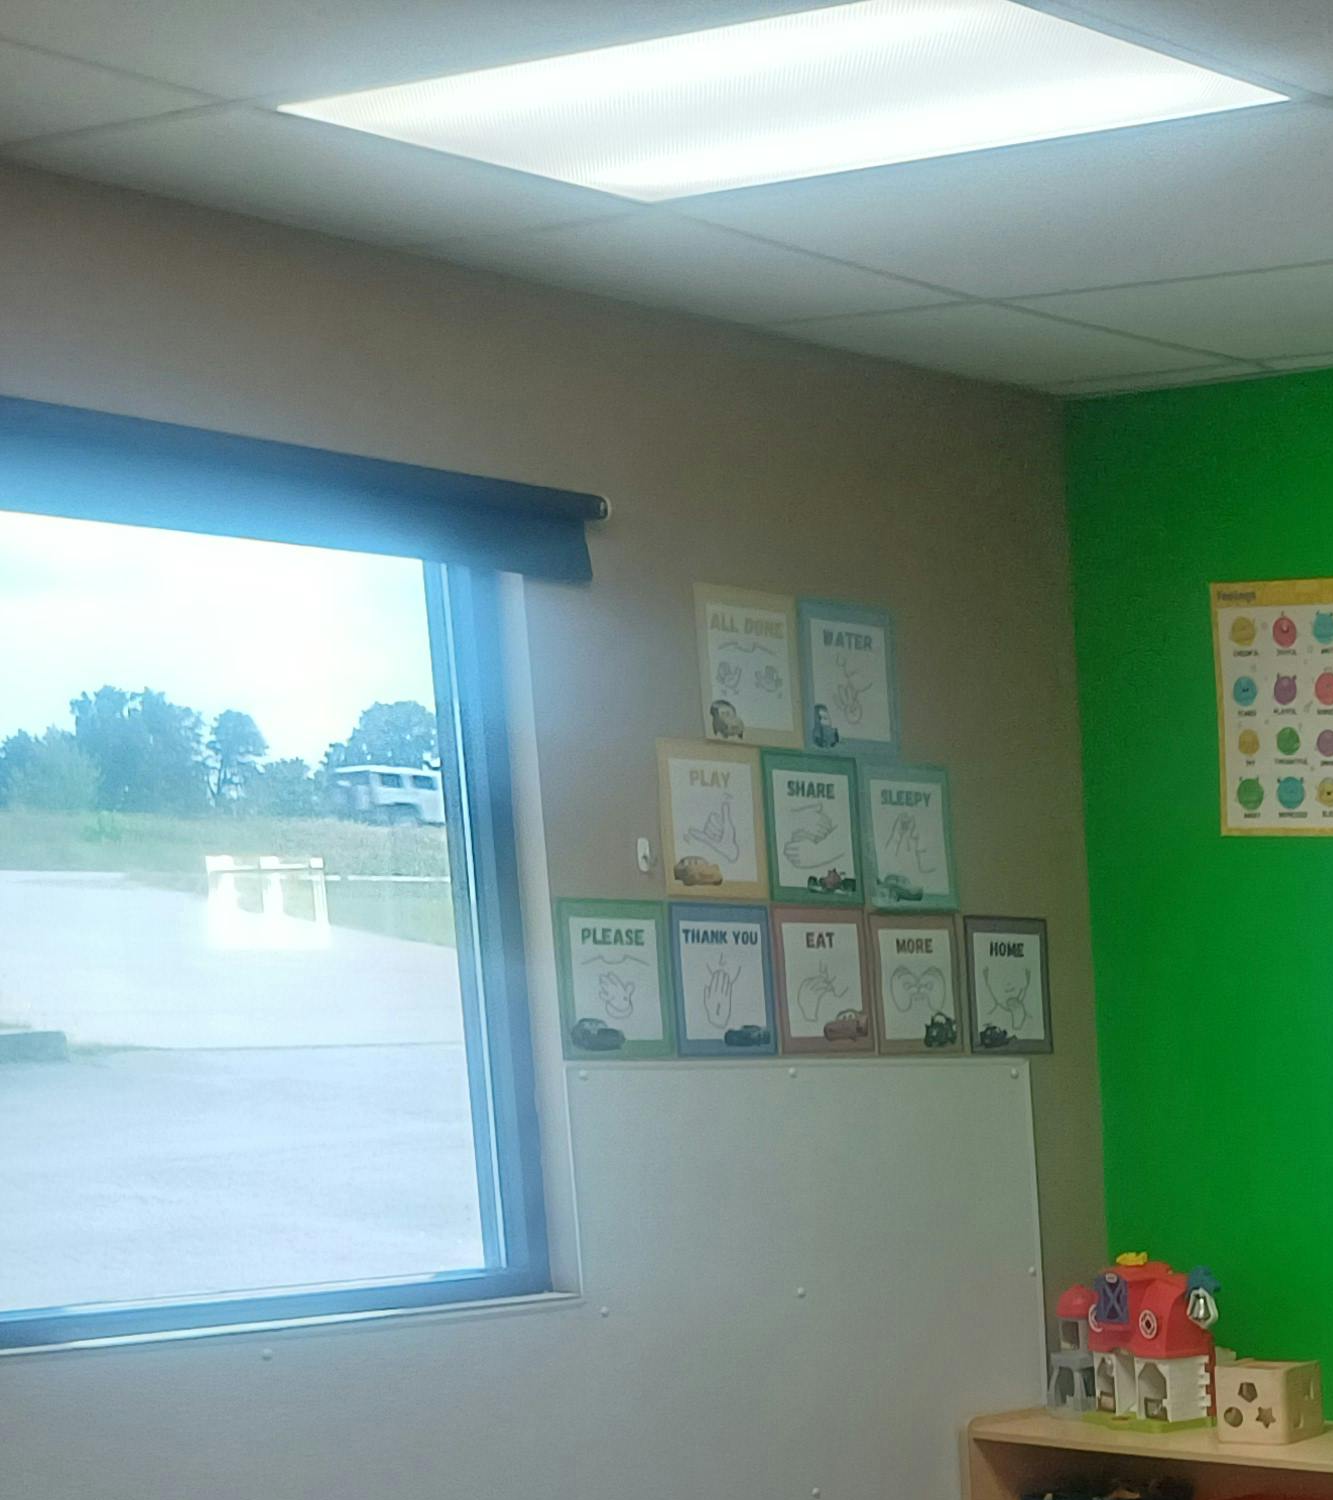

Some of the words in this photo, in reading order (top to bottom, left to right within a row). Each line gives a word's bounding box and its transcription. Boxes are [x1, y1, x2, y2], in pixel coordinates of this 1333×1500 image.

[711, 613, 738, 633] ALL
[823, 628, 872, 651] WATER
[689, 769, 730, 789] PLAY
[786, 780, 836, 800] SHARE
[880, 789, 932, 809] SLEEPY
[581, 928, 645, 947] PLEASE
[682, 928, 727, 945] THANK
[732, 930, 758, 945] YOU
[806, 931, 835, 950] EAT
[895, 938, 933, 954] MORE
[990, 941, 1024, 958] HOME
